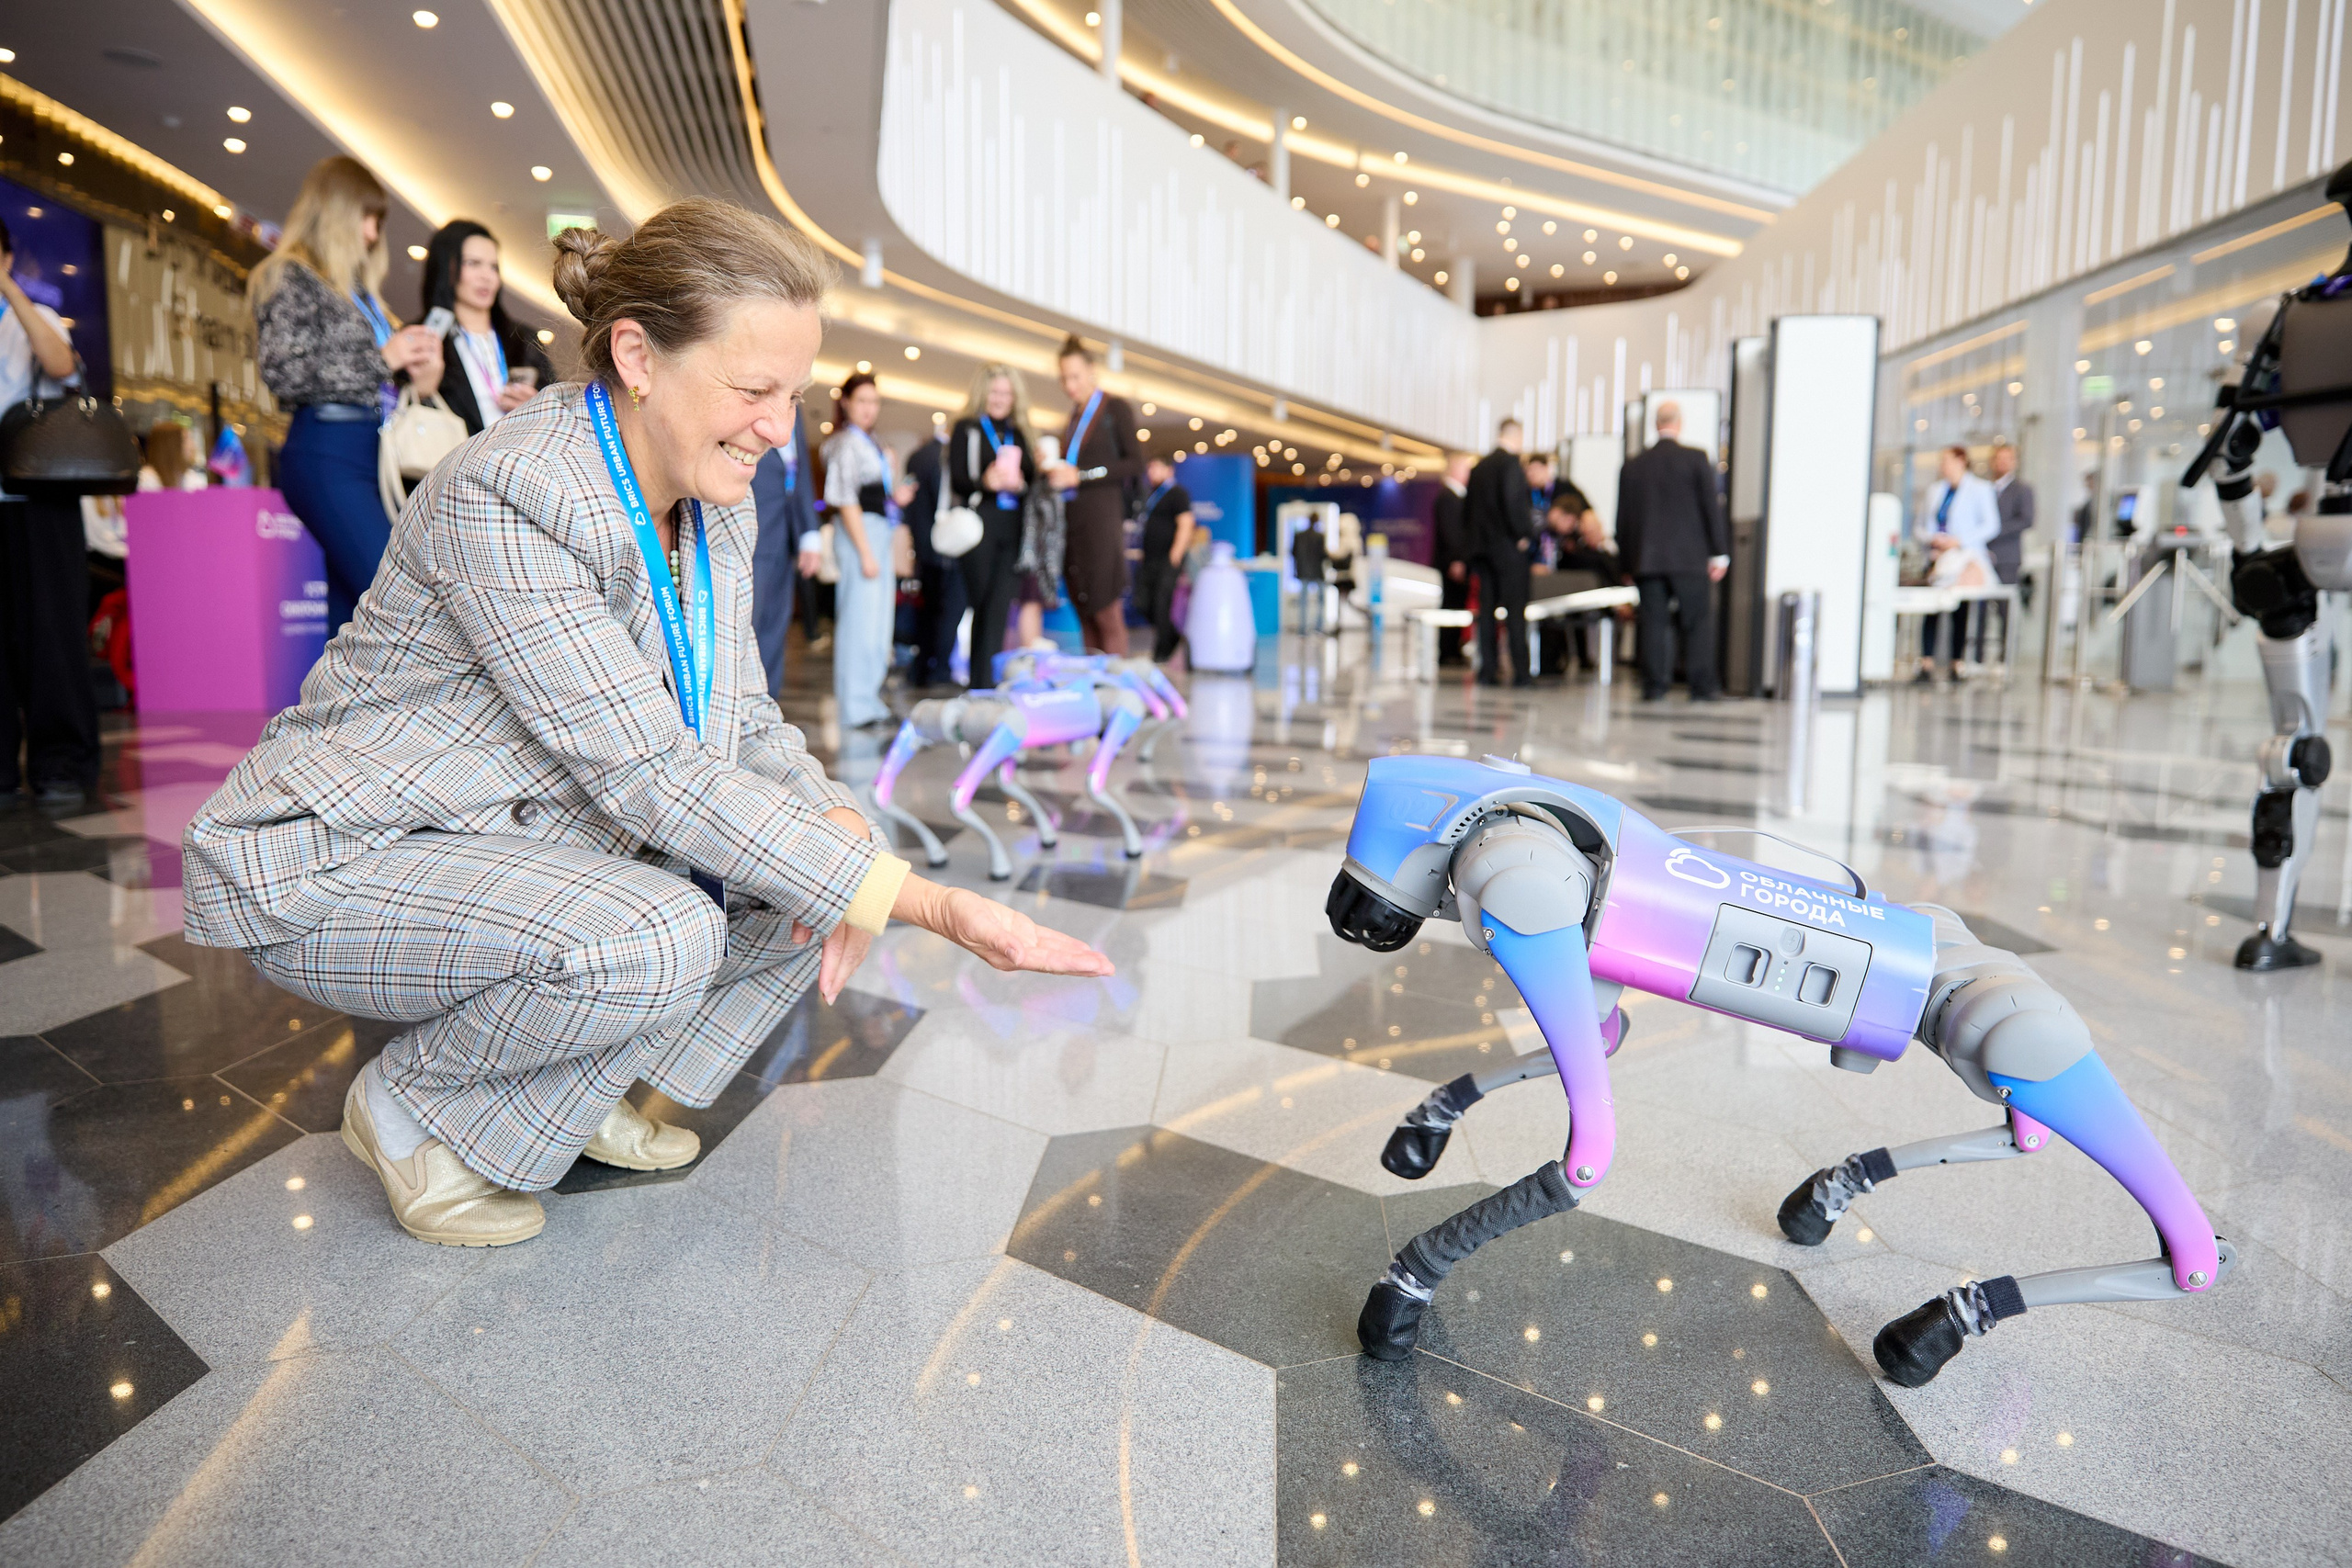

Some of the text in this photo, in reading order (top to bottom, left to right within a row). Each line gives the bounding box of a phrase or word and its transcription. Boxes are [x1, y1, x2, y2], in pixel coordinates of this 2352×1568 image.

[593, 378, 639, 508] BRICS URBAN FUTURE FOR
[698, 607, 707, 637] BRICS
[660, 586, 695, 724] BRICS URBAN FUTURE FORUM
[698, 638, 707, 671] URBAN
[1739, 871, 1886, 920] ОБЛАЧНЫЕ
[1740, 882, 1847, 928] ГОРОДА
